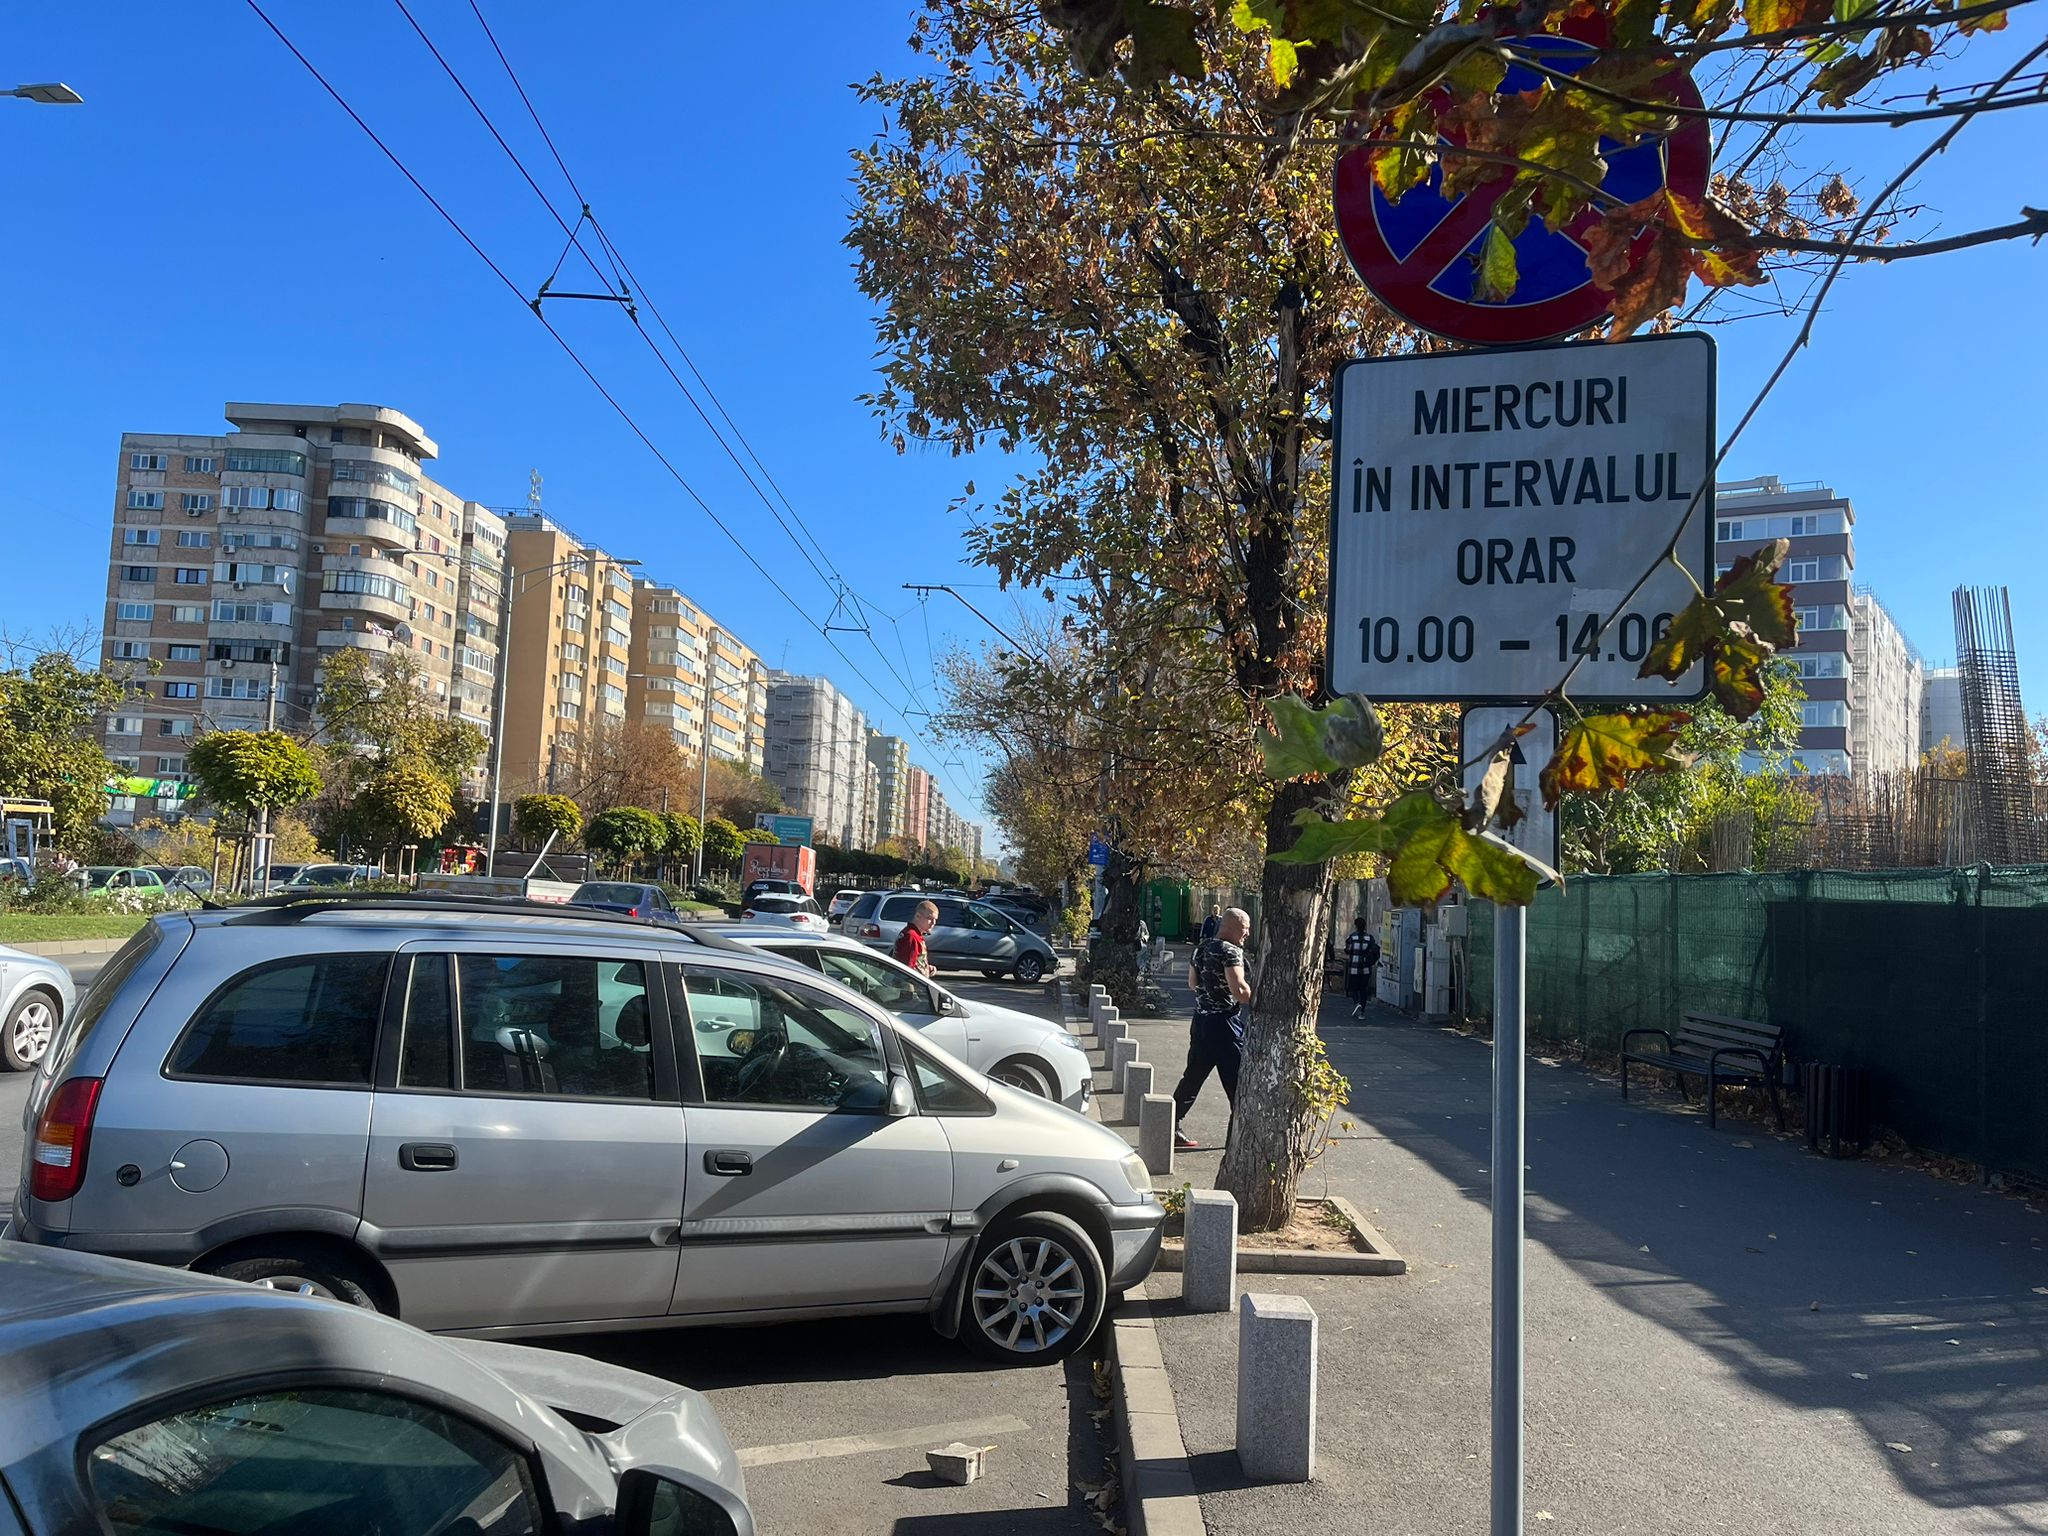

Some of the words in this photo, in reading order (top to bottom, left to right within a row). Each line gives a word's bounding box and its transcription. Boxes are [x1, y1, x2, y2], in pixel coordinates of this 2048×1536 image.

[1413, 375, 1627, 436] MIERCURI
[1352, 457, 1392, 514] ÎN
[1410, 451, 1692, 511] INTERVALUL
[1456, 536, 1577, 586] ORAR
[1358, 615, 1475, 664] 10.00
